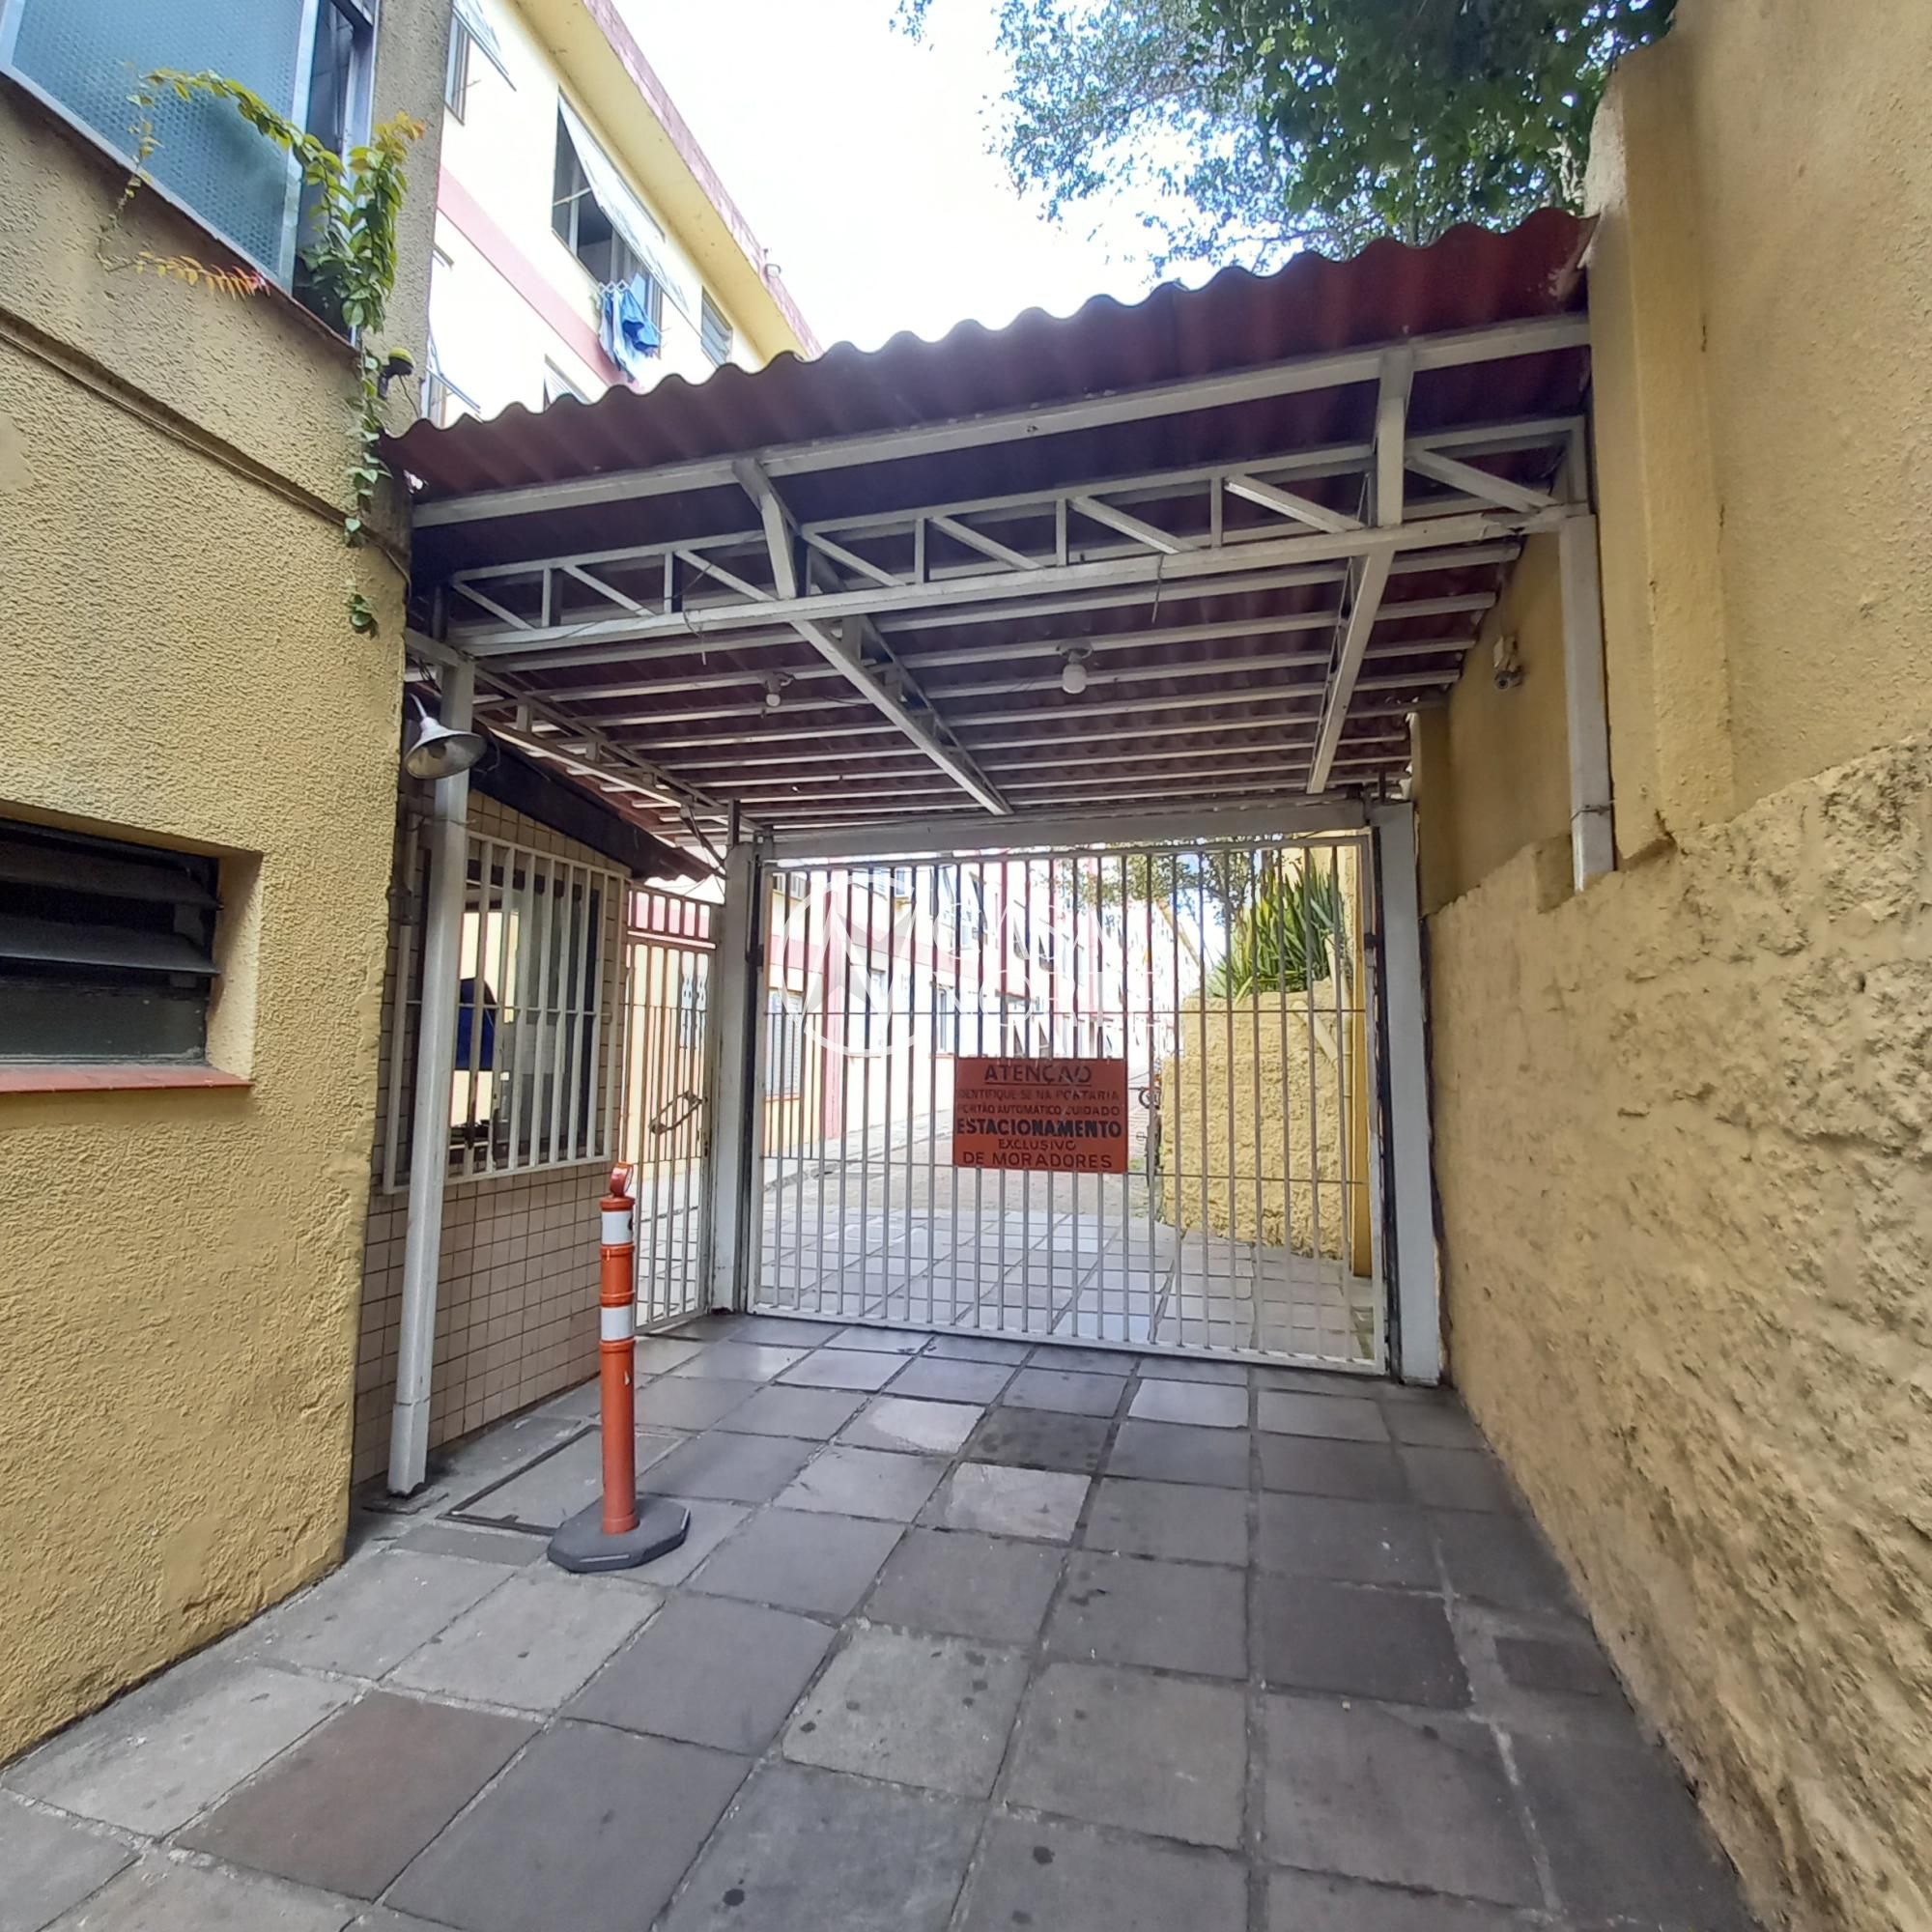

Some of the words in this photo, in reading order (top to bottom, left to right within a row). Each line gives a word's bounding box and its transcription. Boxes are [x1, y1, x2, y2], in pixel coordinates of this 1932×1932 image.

[1036, 1090, 1052, 1100] NA
[1055, 1089, 1120, 1101] PORTARIA
[1065, 1105, 1121, 1117] CUIDADO
[956, 1119, 1122, 1138] ESTACIONAMENTO
[998, 1138, 1077, 1151] EXCLUSIVO
[962, 1151, 985, 1164] DE
[992, 1151, 1113, 1169] MORADORES
